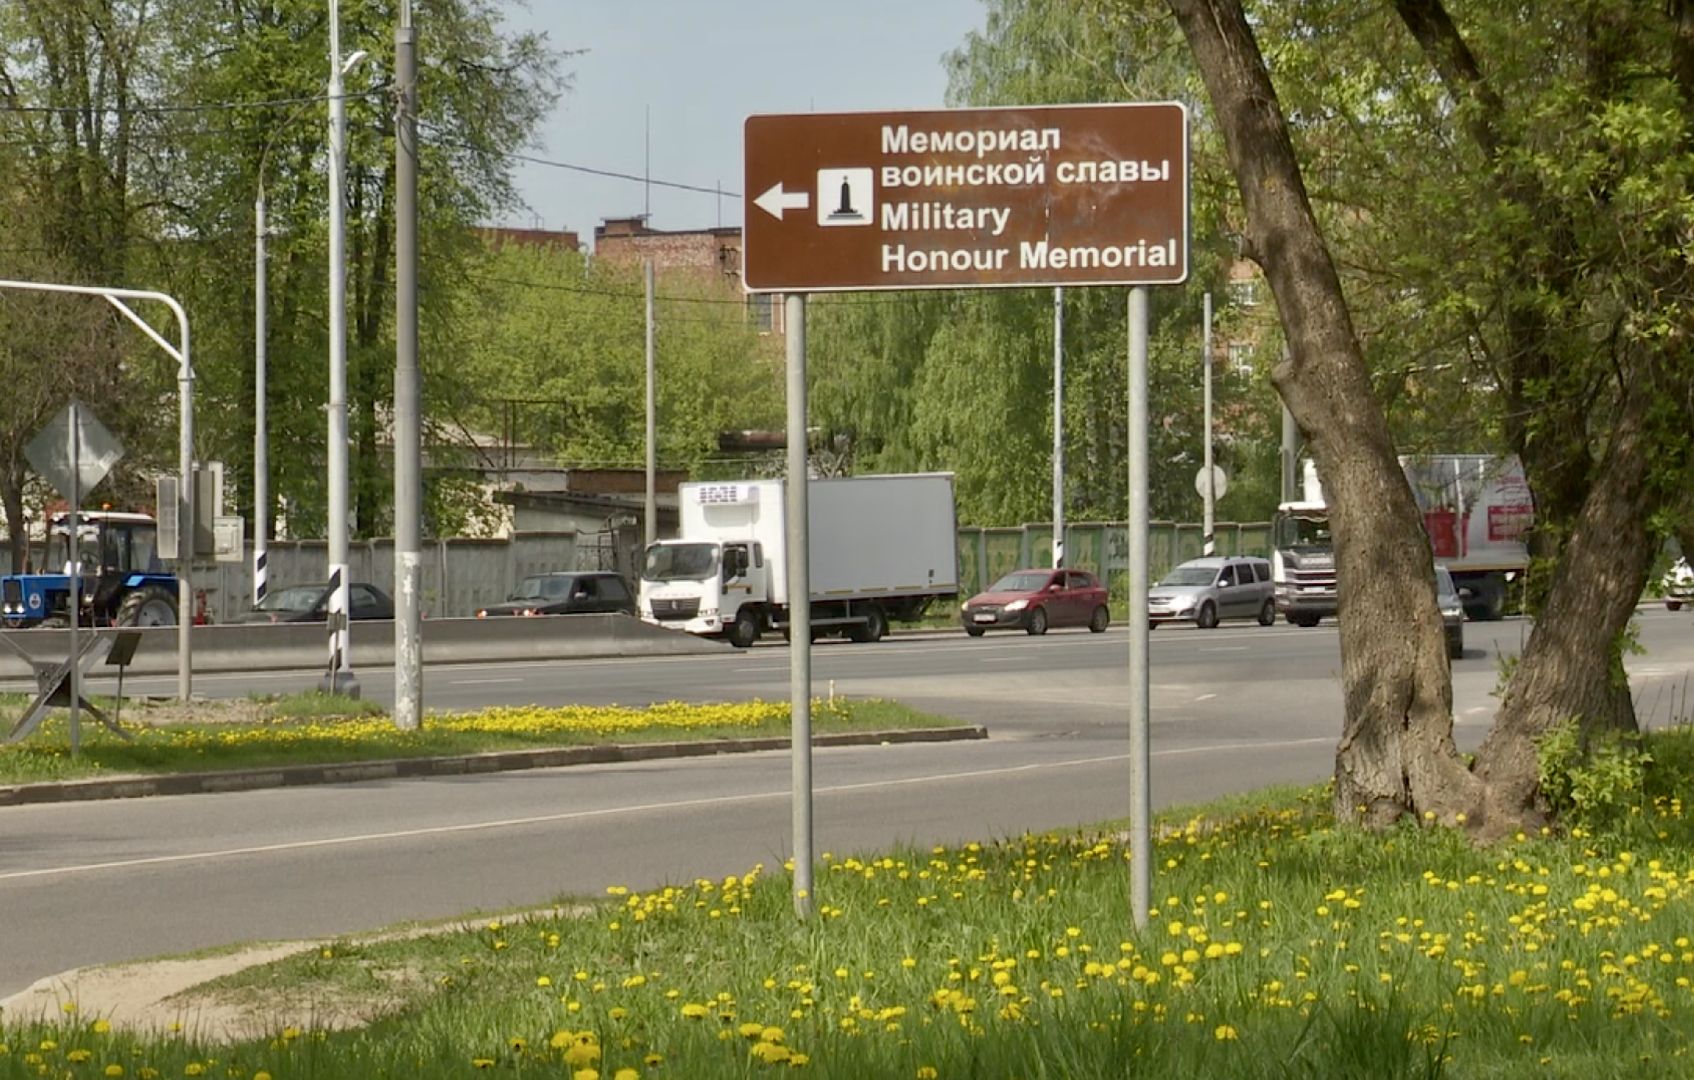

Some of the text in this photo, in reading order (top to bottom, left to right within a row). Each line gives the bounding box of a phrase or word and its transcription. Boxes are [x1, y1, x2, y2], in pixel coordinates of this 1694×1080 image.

[881, 125, 1061, 159] Мемориал
[881, 155, 1170, 187] воинской славы
[881, 202, 1011, 236] Military
[882, 238, 1177, 272] Honour Memorial
